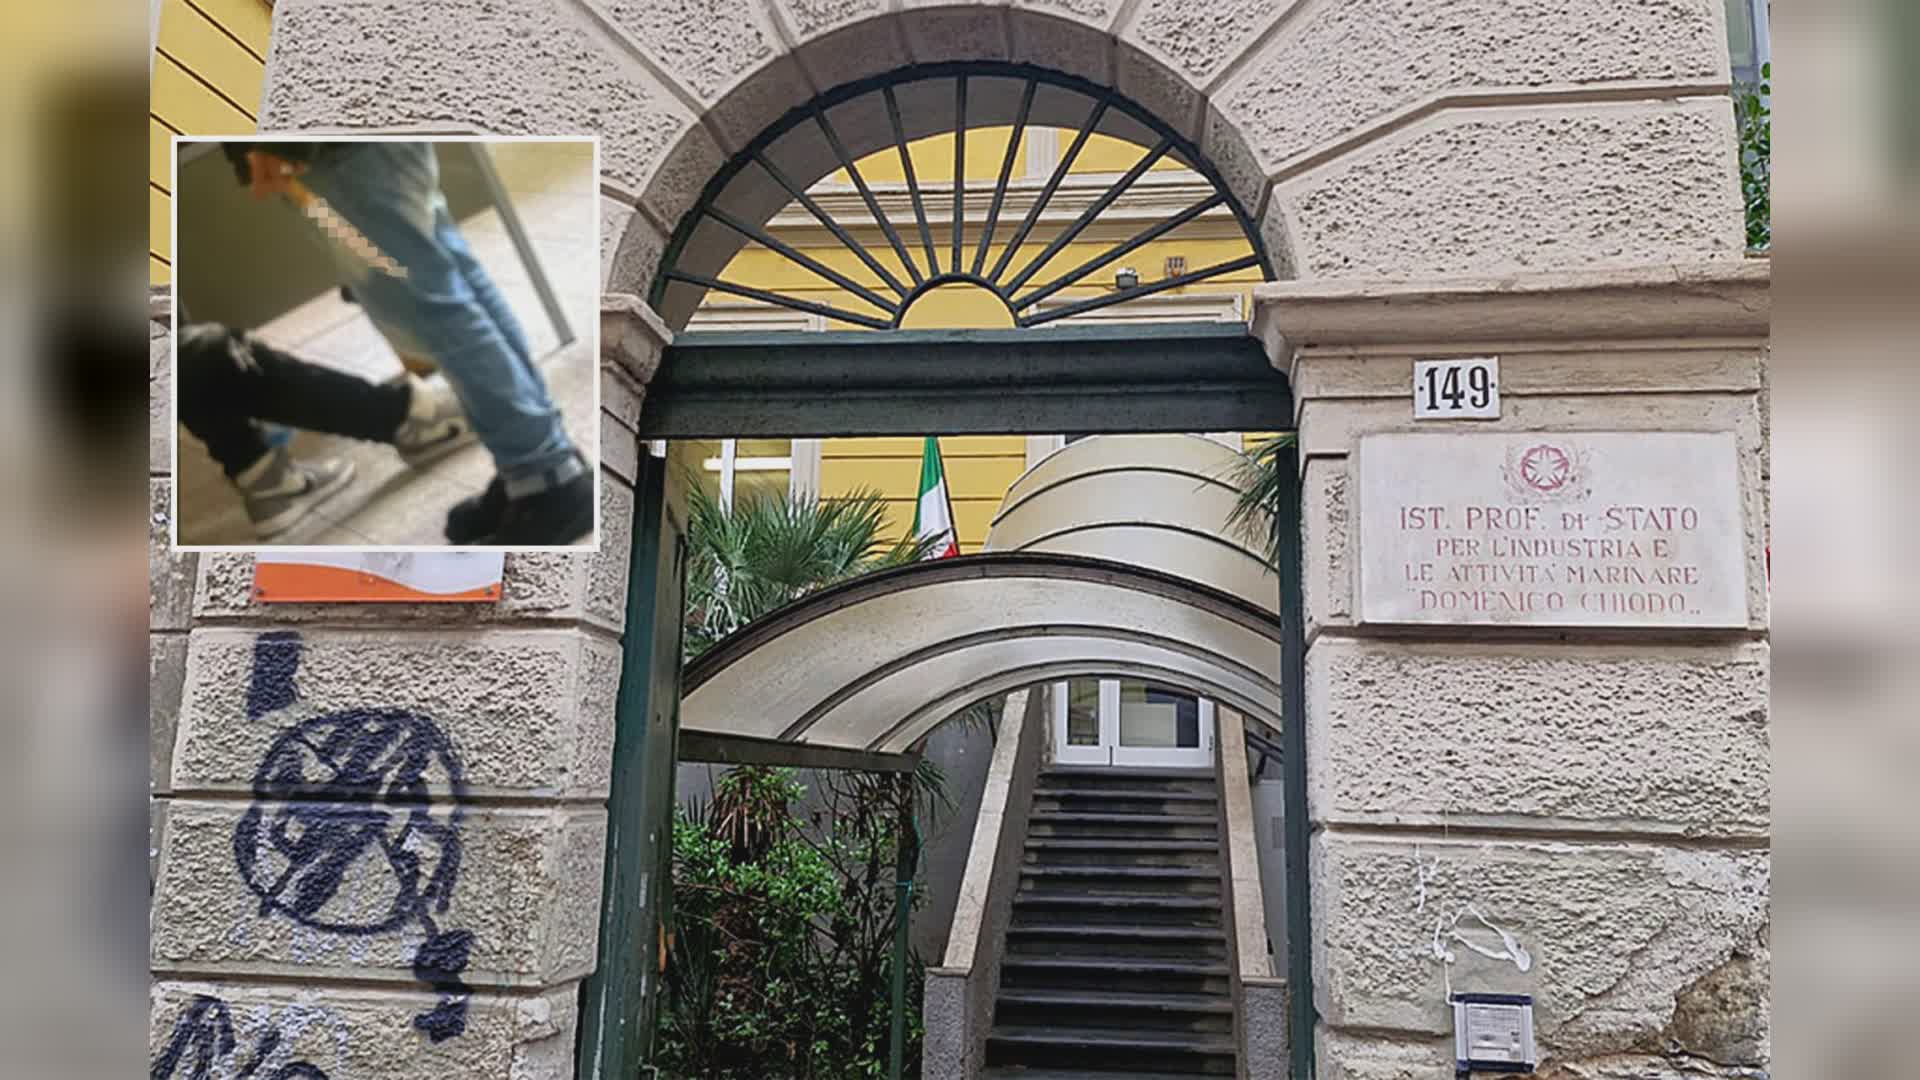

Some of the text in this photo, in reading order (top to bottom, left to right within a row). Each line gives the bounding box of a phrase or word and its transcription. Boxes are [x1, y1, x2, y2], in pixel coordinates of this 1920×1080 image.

[1425, 365, 1490, 411] 149
[1400, 506, 1450, 530] IST.
[1466, 506, 1546, 530] PROF.
[1605, 506, 1698, 531] STATO
[1436, 536, 1669, 558] PER L'INDUSTRIA E
[1405, 563, 1433, 582] LE
[1566, 565, 1698, 585] MARINARE
